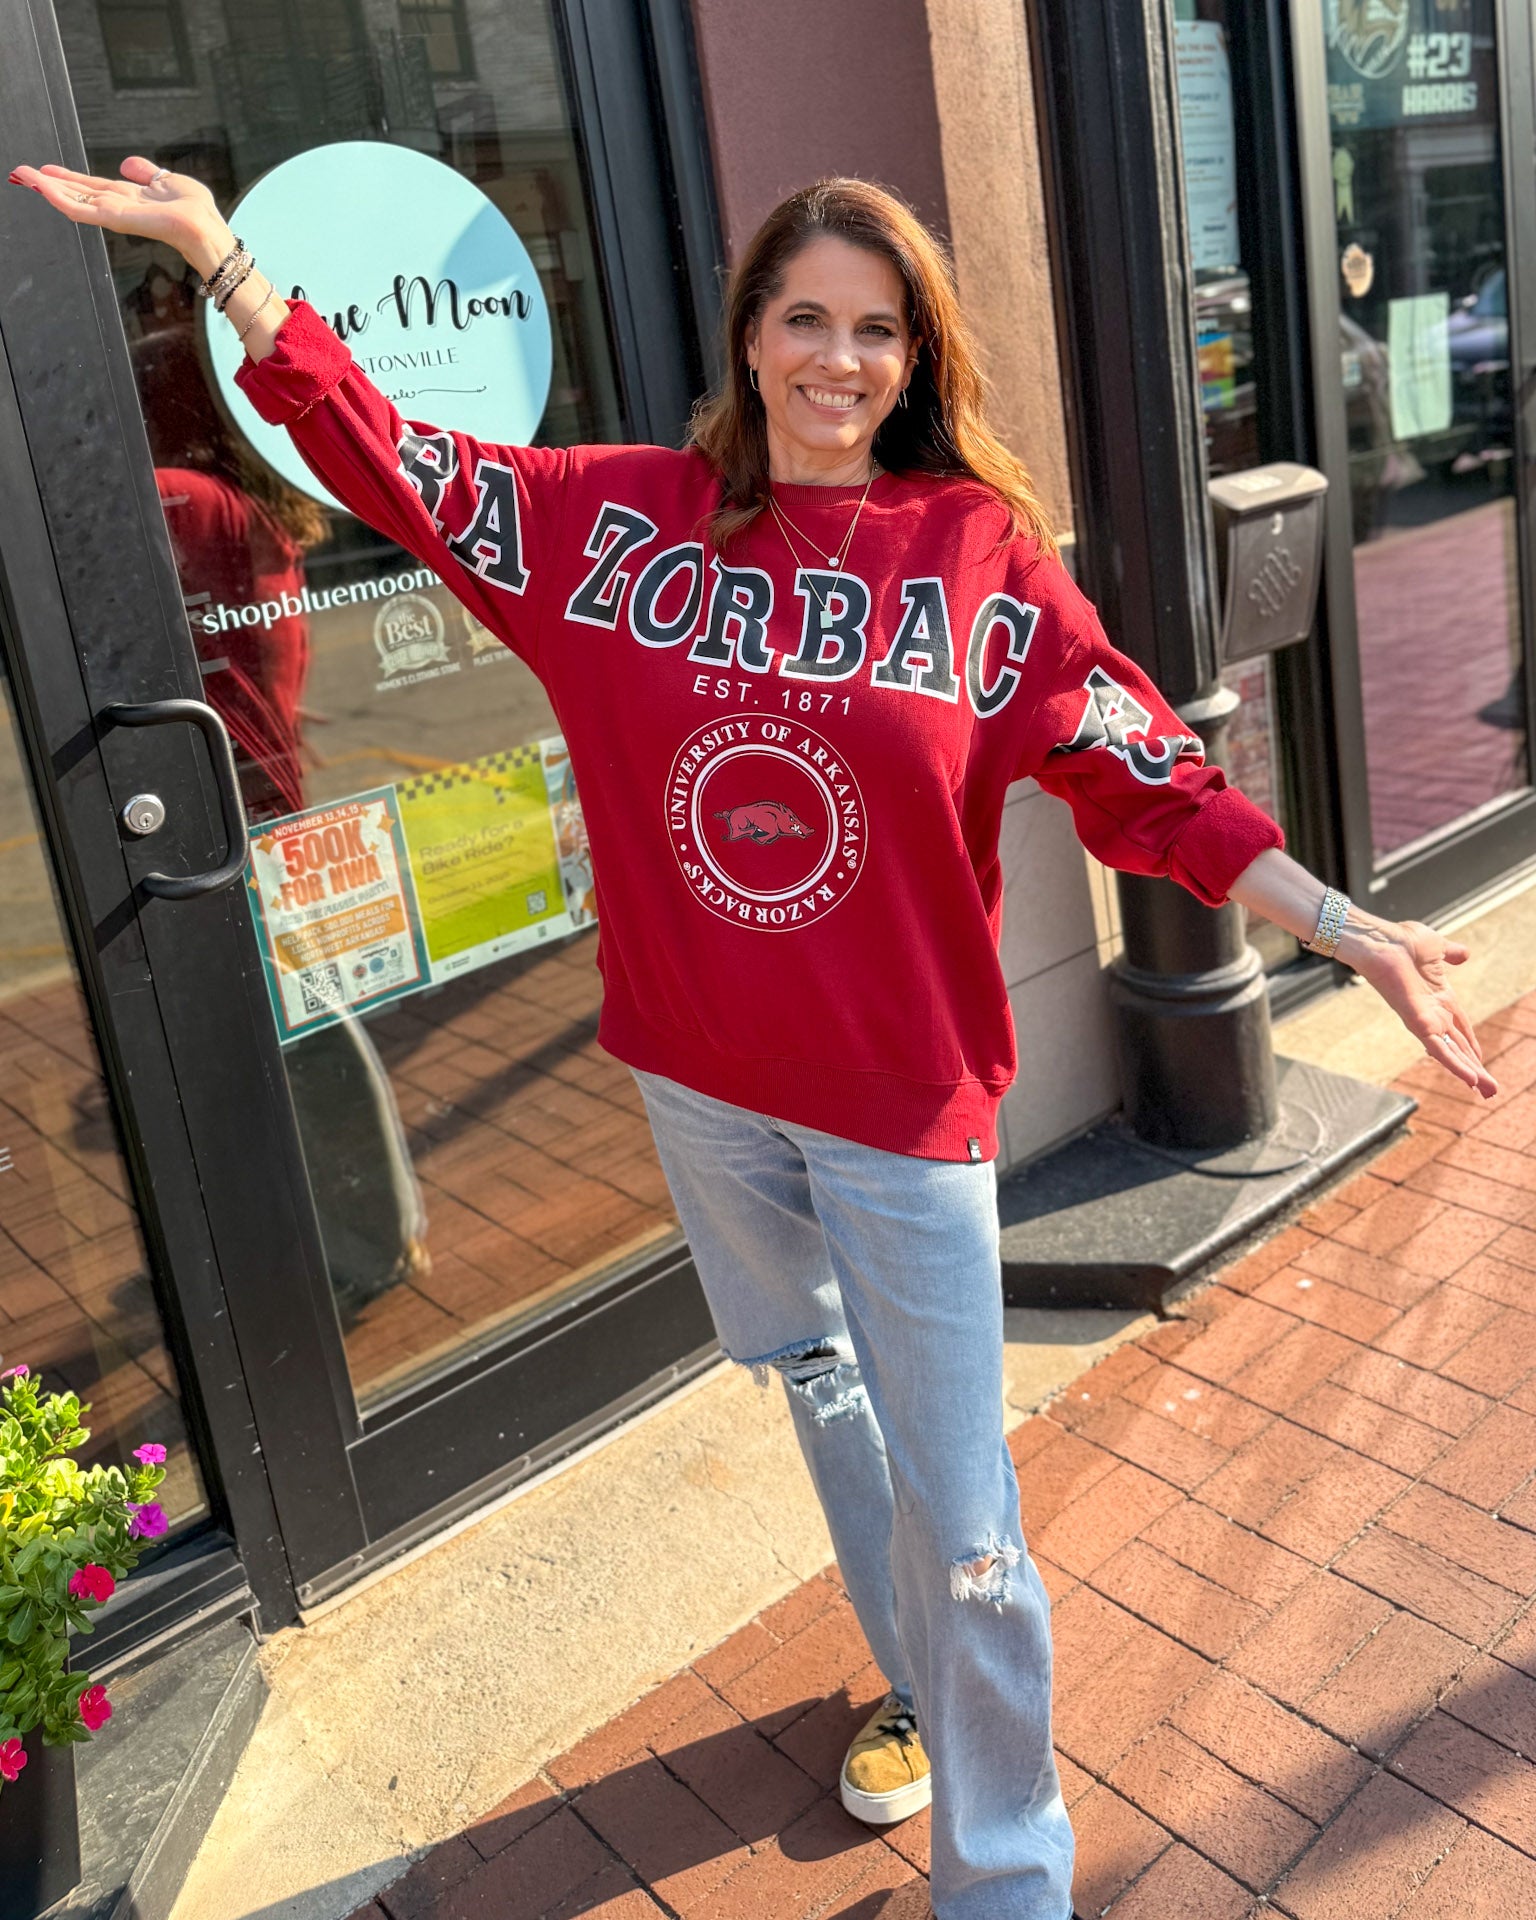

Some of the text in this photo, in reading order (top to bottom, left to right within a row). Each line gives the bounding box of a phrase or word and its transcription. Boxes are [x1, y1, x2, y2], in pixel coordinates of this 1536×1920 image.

[1406, 32, 1472, 78] #23
[1402, 82, 1478, 116] HARRIS
[377, 274, 531, 330] Moon
[361, 346, 460, 373] TONVILLE
[385, 615, 432, 645] Best
[693, 674, 850, 715] EST. 1871
[671, 721, 750, 830] UNIVERSITY
[761, 722, 792, 742] OF
[275, 816, 323, 838] NOVEMBER
[420, 835, 477, 858] Ready
[481, 824, 508, 839] for
[282, 820, 367, 878] 500K
[422, 855, 461, 875] Bike
[464, 835, 514, 861] Ride?
[280, 872, 326, 911] FOR
[328, 854, 382, 895] NWA
[281, 934, 302, 946] HELP
[303, 926, 322, 939] PACK
[355, 906, 380, 920] MEALS
[292, 914, 390, 955] LOCAL NONPROFITS ACROSS
